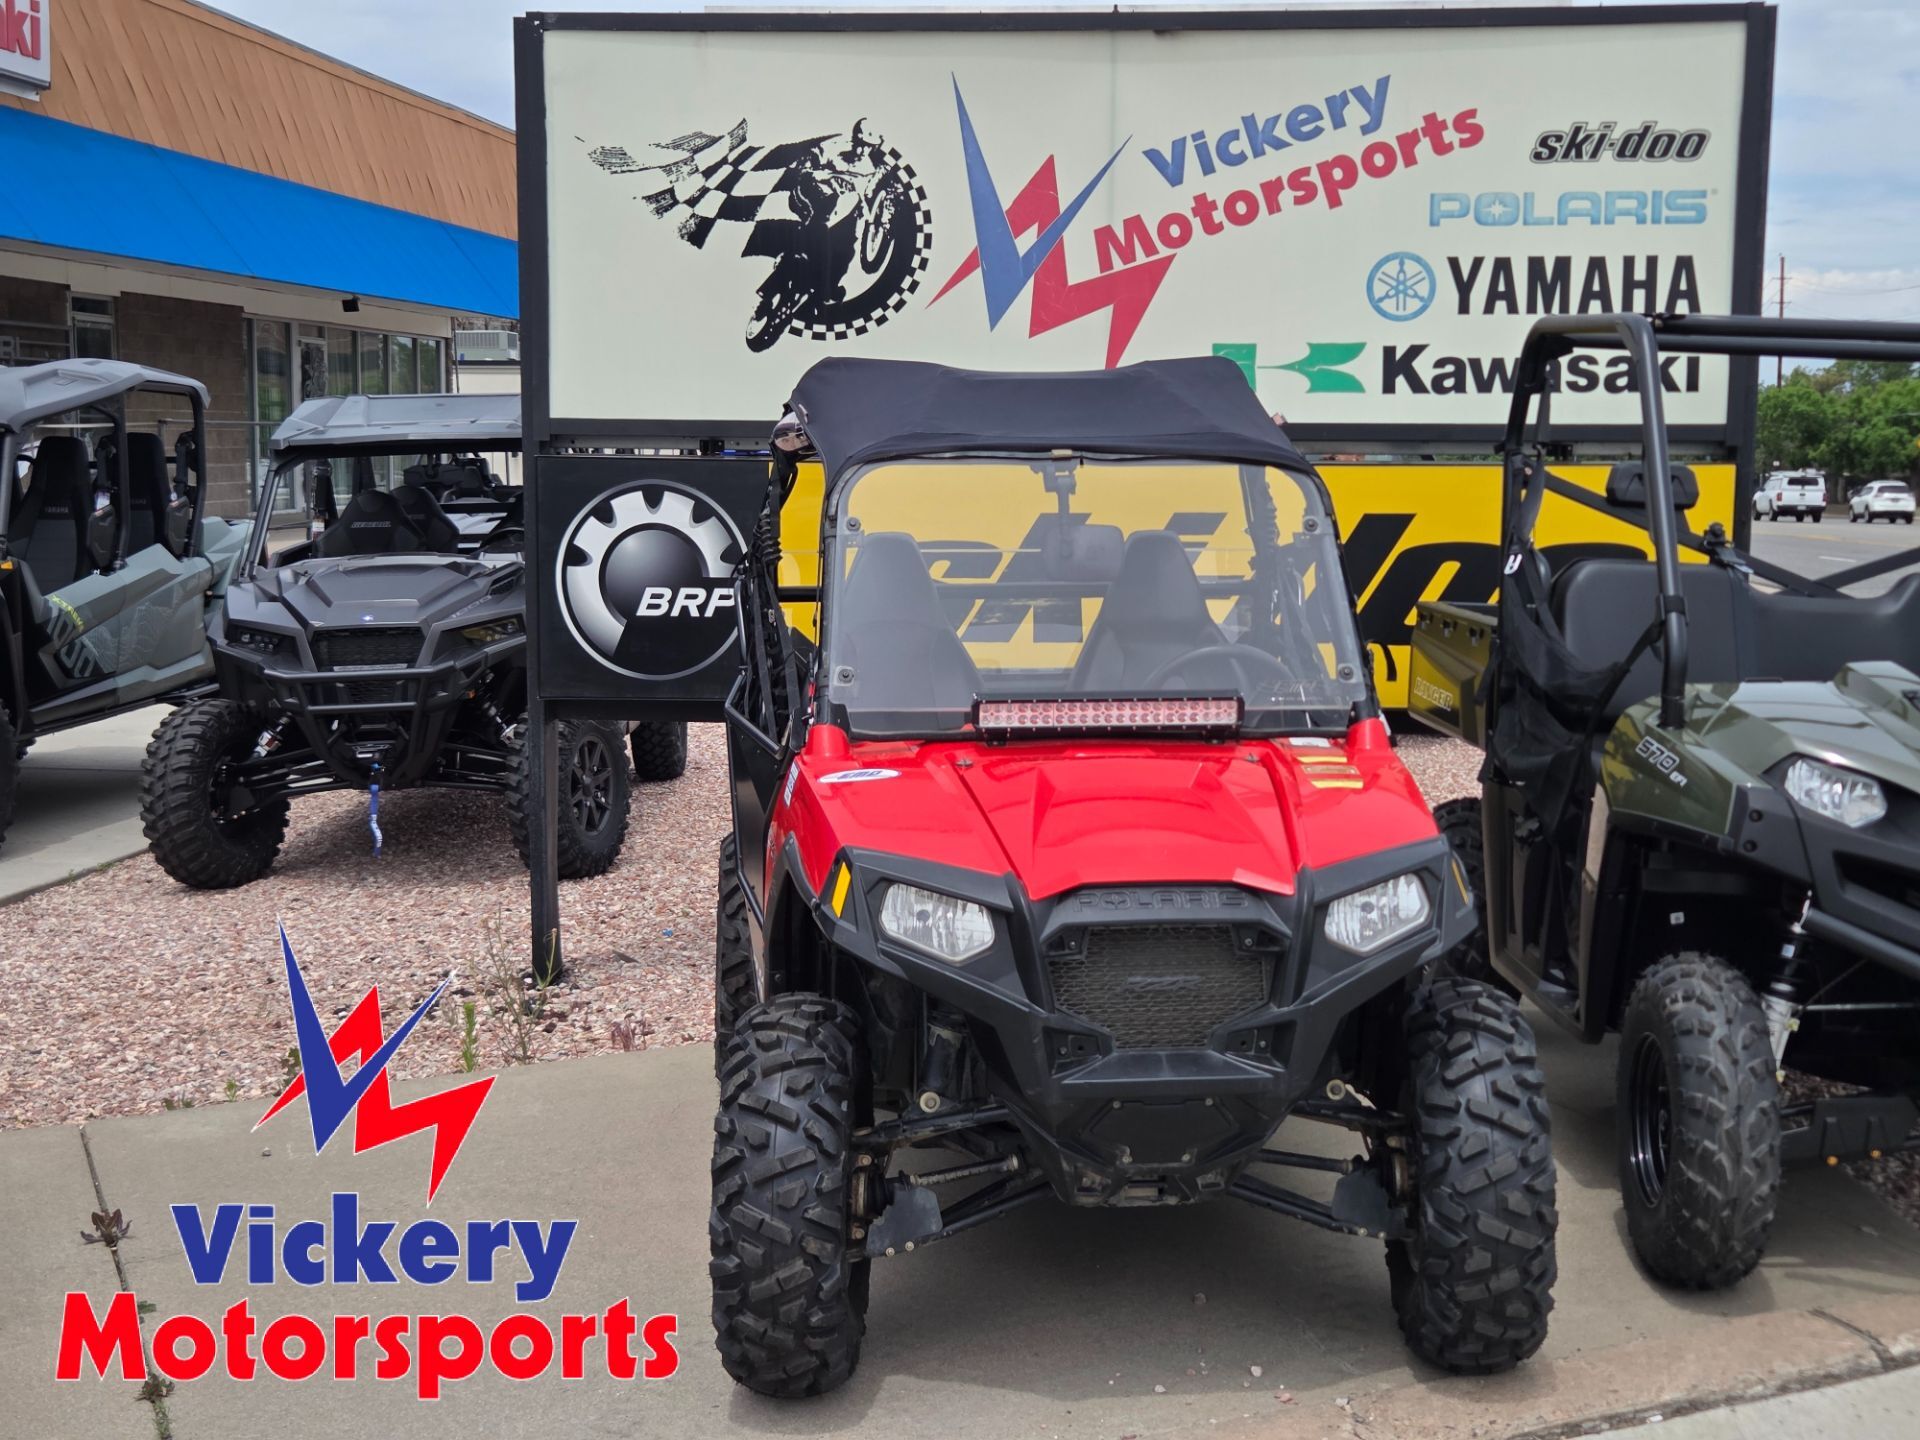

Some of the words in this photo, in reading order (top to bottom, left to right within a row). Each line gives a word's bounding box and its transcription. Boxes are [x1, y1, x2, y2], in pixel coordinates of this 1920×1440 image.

[1142, 74, 1391, 187] Vickery
[1530, 121, 1712, 164] ski-doo
[1093, 108, 1484, 274] Motorsports
[1429, 190, 1708, 226] POLARIS
[1447, 255, 1702, 315] YAMAHA
[636, 586, 736, 617] BRP
[1413, 676, 1453, 711] RANGER
[1635, 735, 1680, 774] 570
[1073, 888, 1249, 913] POLARIS
